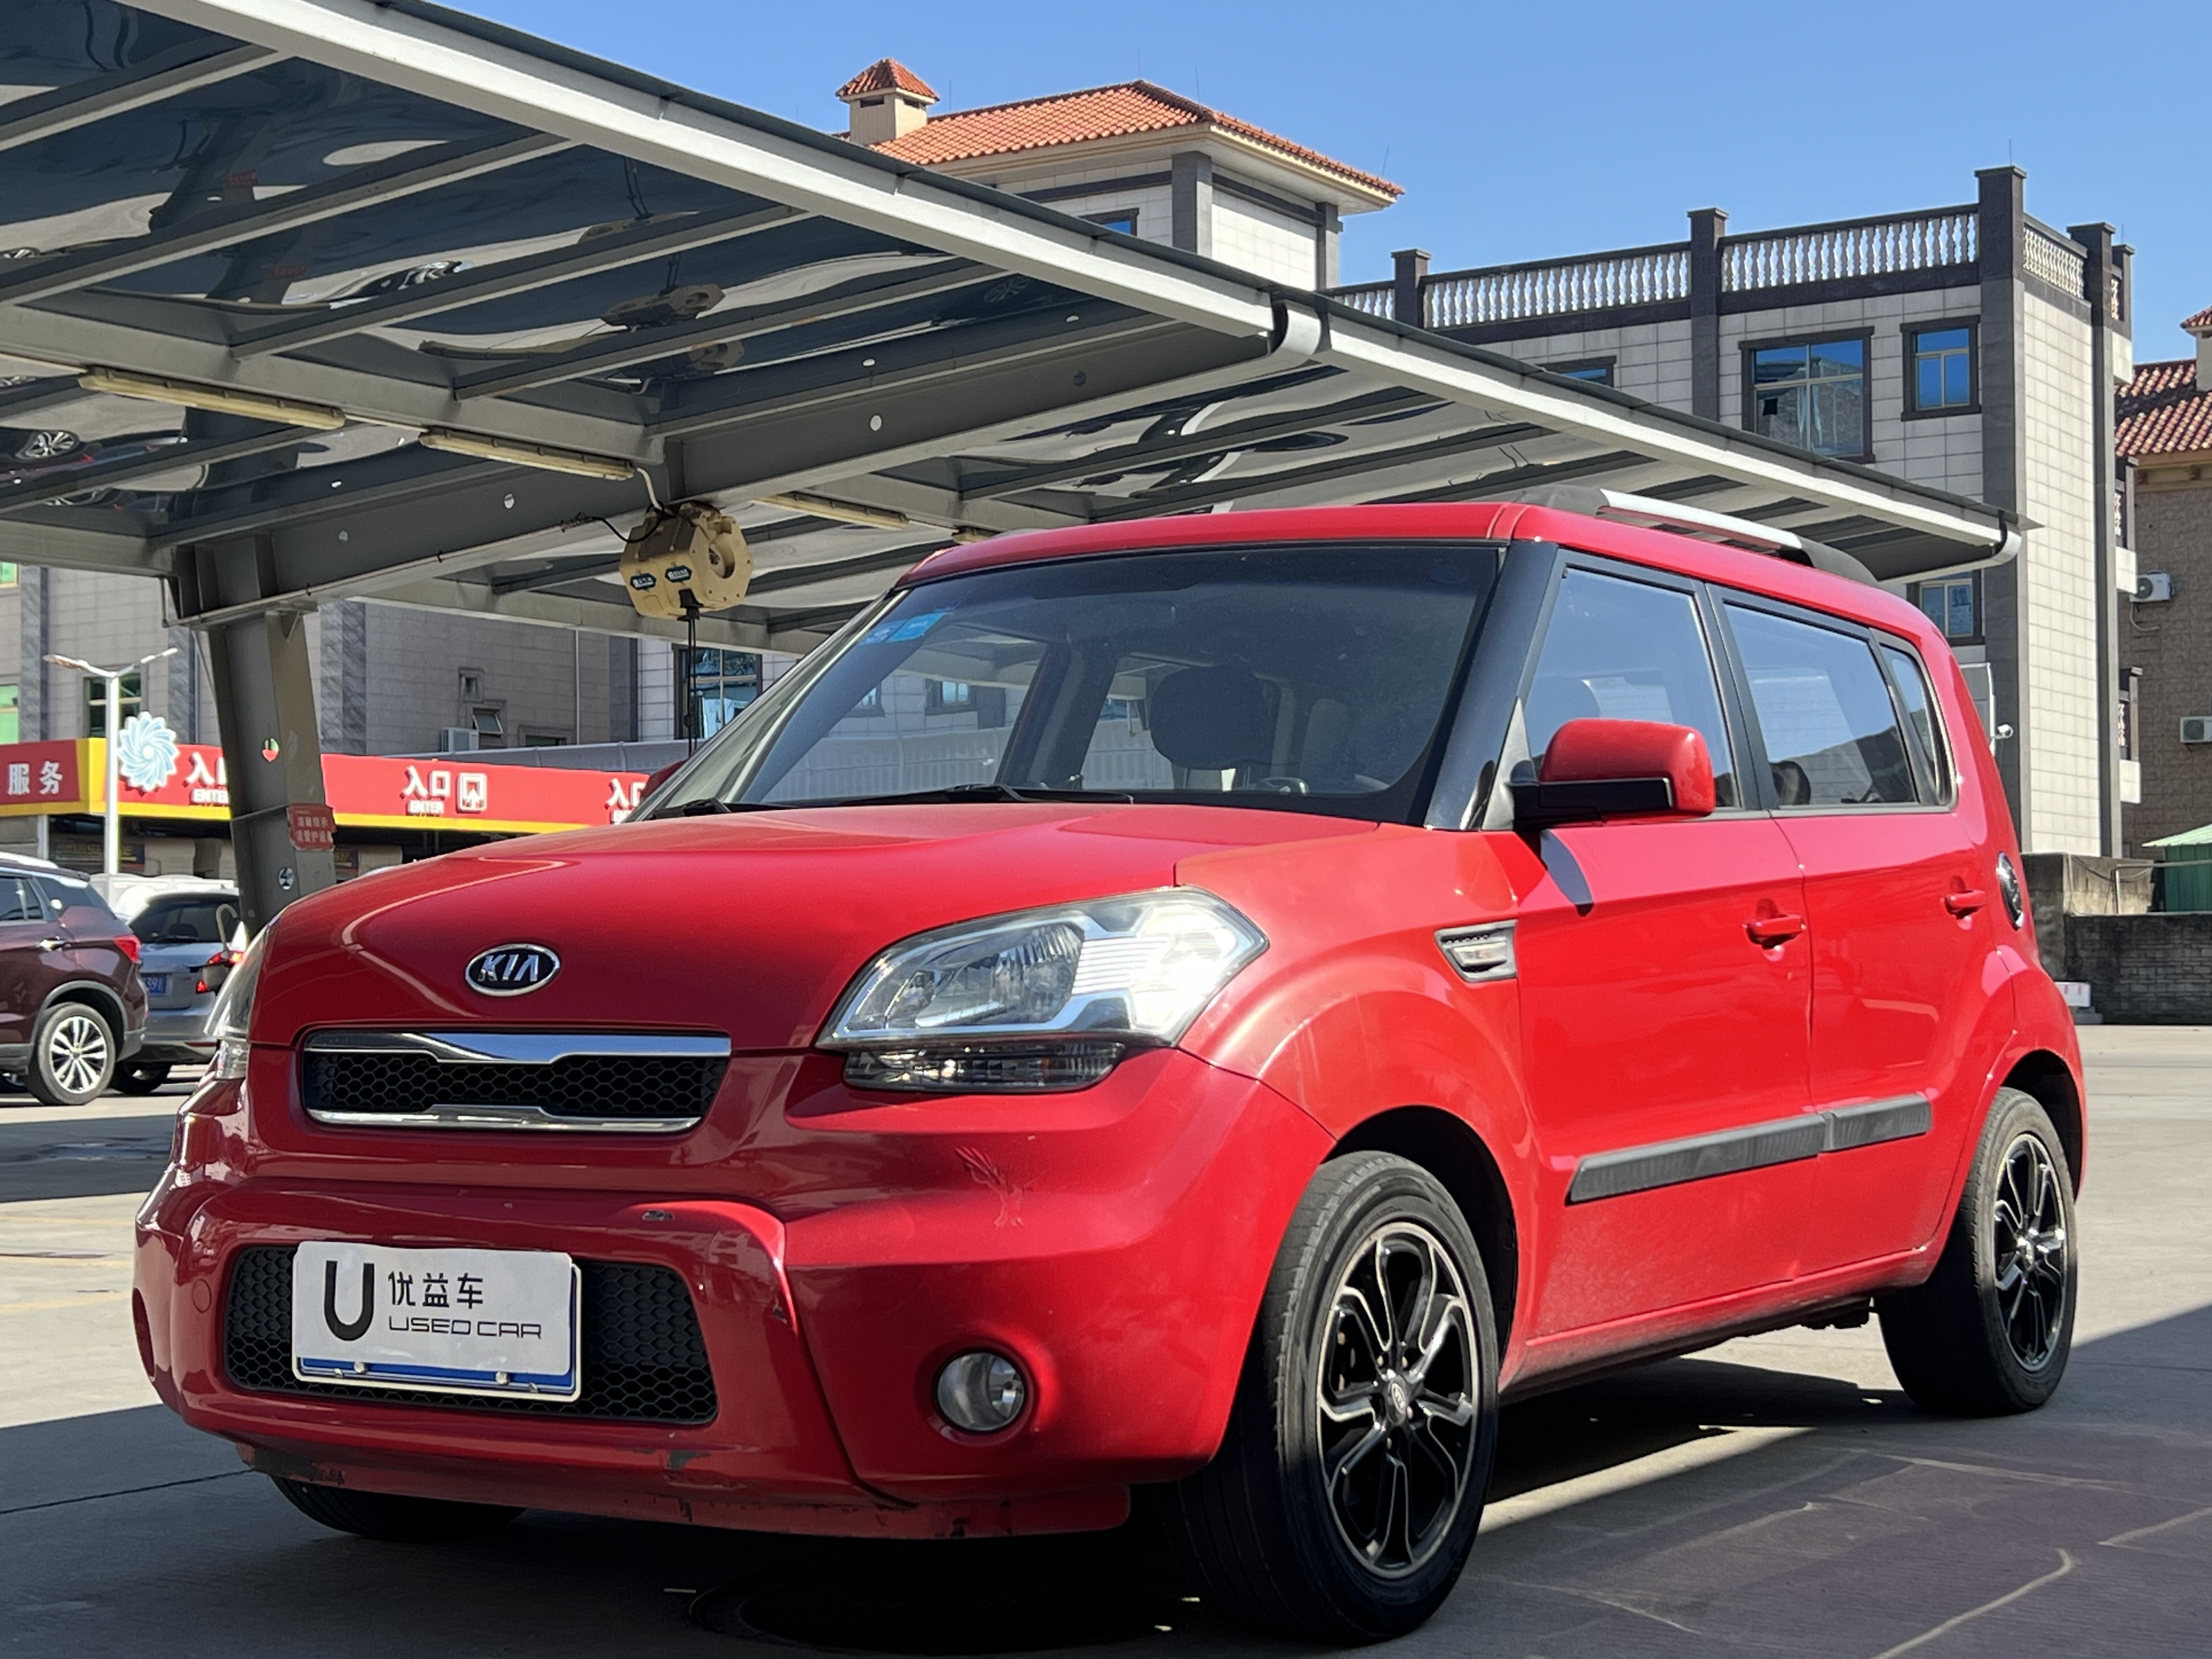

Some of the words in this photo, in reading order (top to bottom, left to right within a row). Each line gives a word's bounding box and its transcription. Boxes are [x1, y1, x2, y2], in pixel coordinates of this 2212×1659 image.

[8, 760, 63, 795] 服务
[403, 765, 450, 798] 入口
[407, 799, 445, 815] ENTER
[477, 953, 539, 981] KIA
[324, 1260, 375, 1341] U
[387, 1270, 484, 1310] 优益车
[388, 1315, 471, 1335] USED
[477, 1321, 542, 1340] CAR
